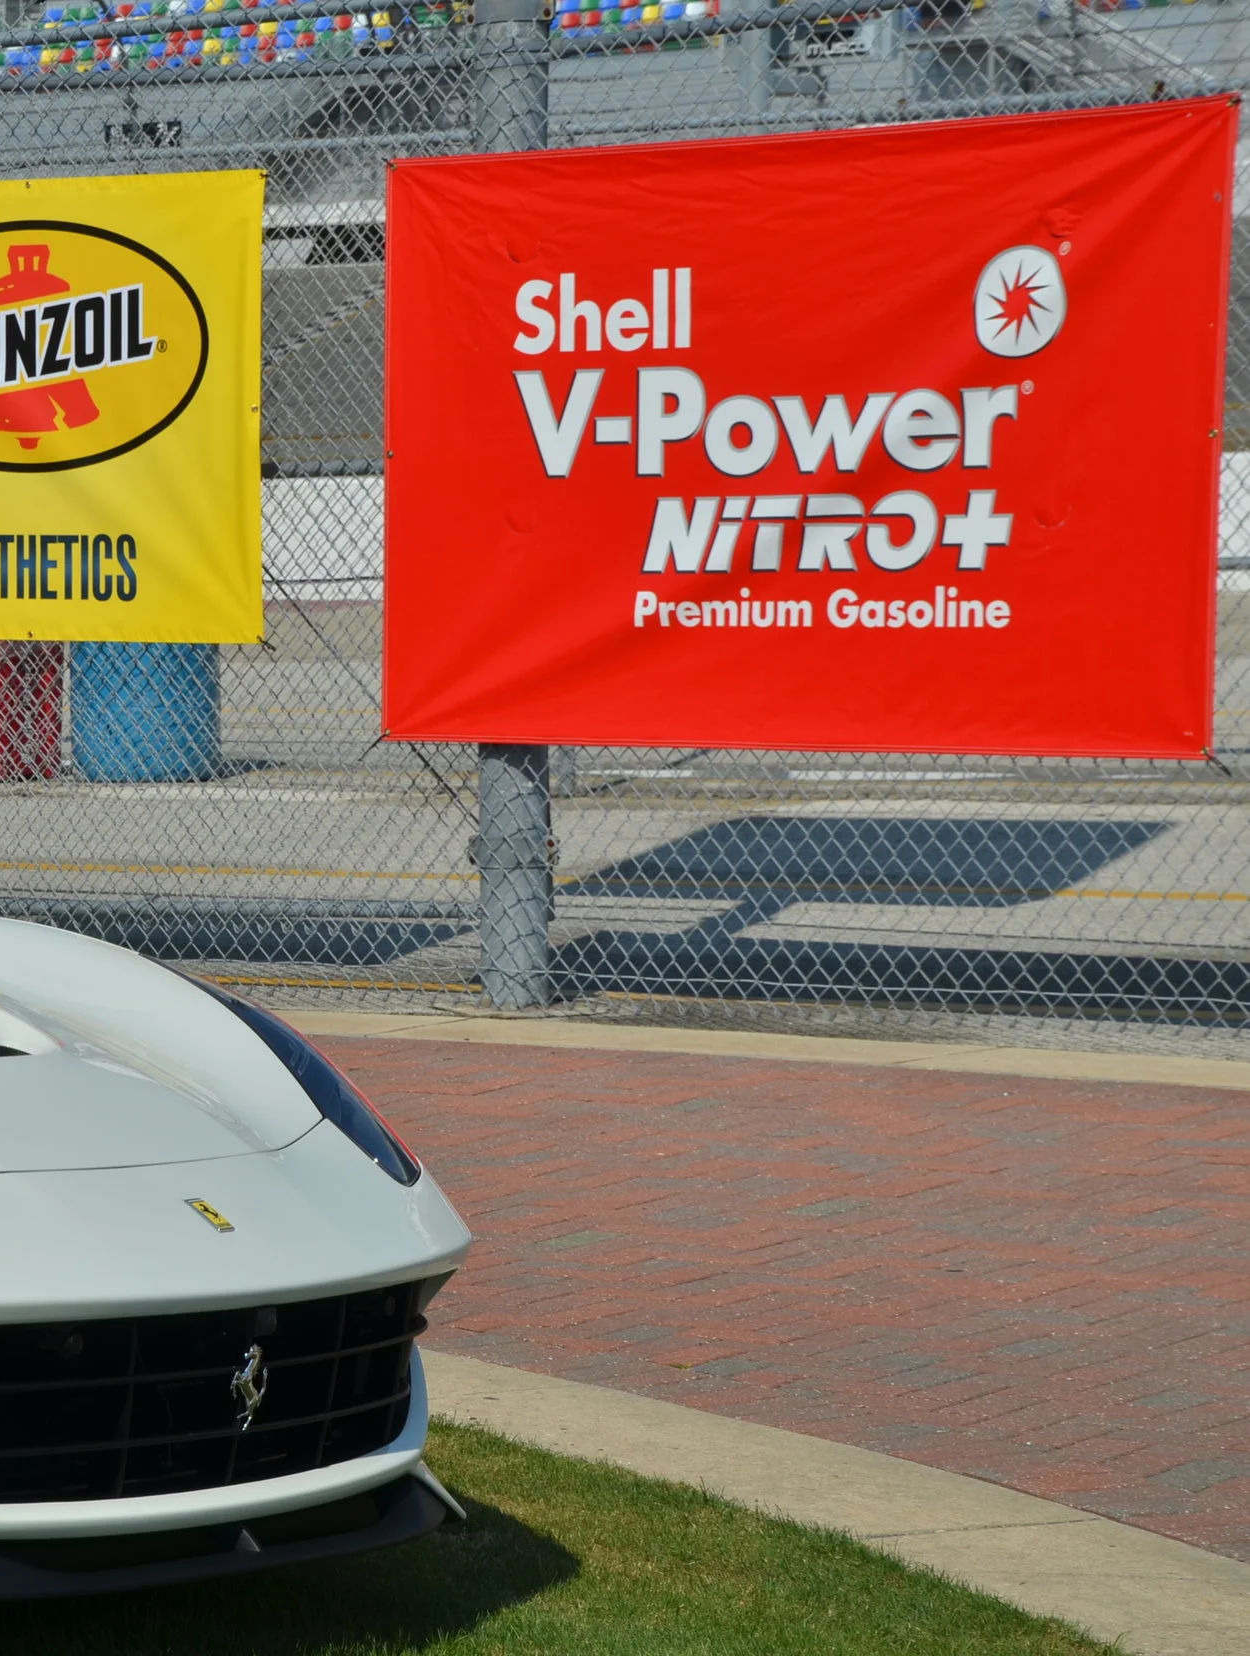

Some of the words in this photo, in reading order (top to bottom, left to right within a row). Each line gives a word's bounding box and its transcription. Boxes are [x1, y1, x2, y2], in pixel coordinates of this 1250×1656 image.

[513, 267, 692, 355] Shell
[513, 366, 1019, 478] V-Power
[634, 586, 812, 629] Premium
[826, 585, 1011, 629] Gasoline
